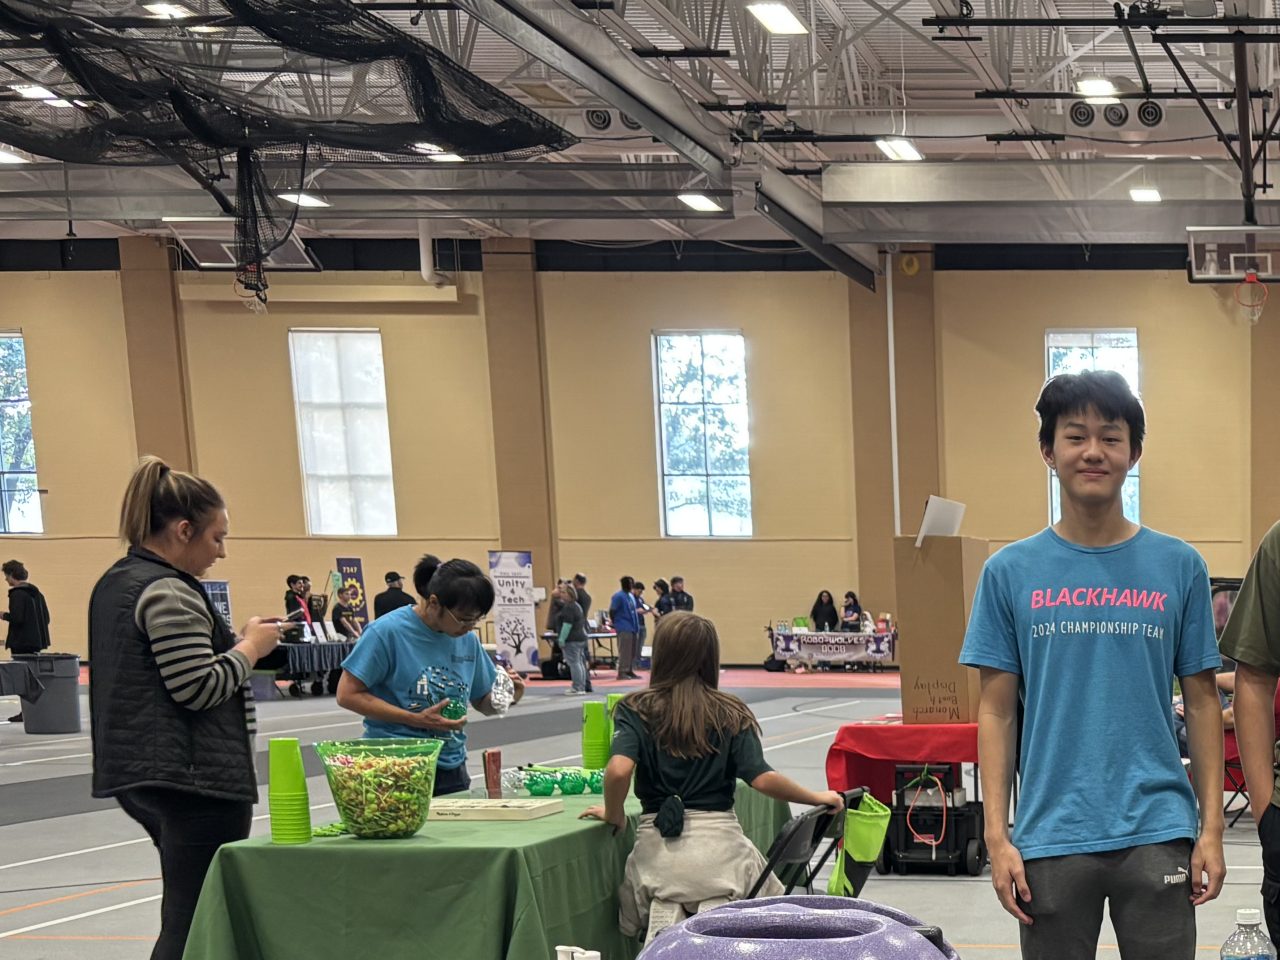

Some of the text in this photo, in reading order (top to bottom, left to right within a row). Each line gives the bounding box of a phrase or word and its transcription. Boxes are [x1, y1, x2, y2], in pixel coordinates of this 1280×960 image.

[498, 579, 526, 589] Unity
[502, 595, 525, 604] Tech
[1031, 587, 1168, 612] BLACKHAWK
[1032, 622, 1056, 638] 2024
[1060, 621, 1139, 635] CHAMPIONSHIP
[913, 706, 960, 720] Monarch
